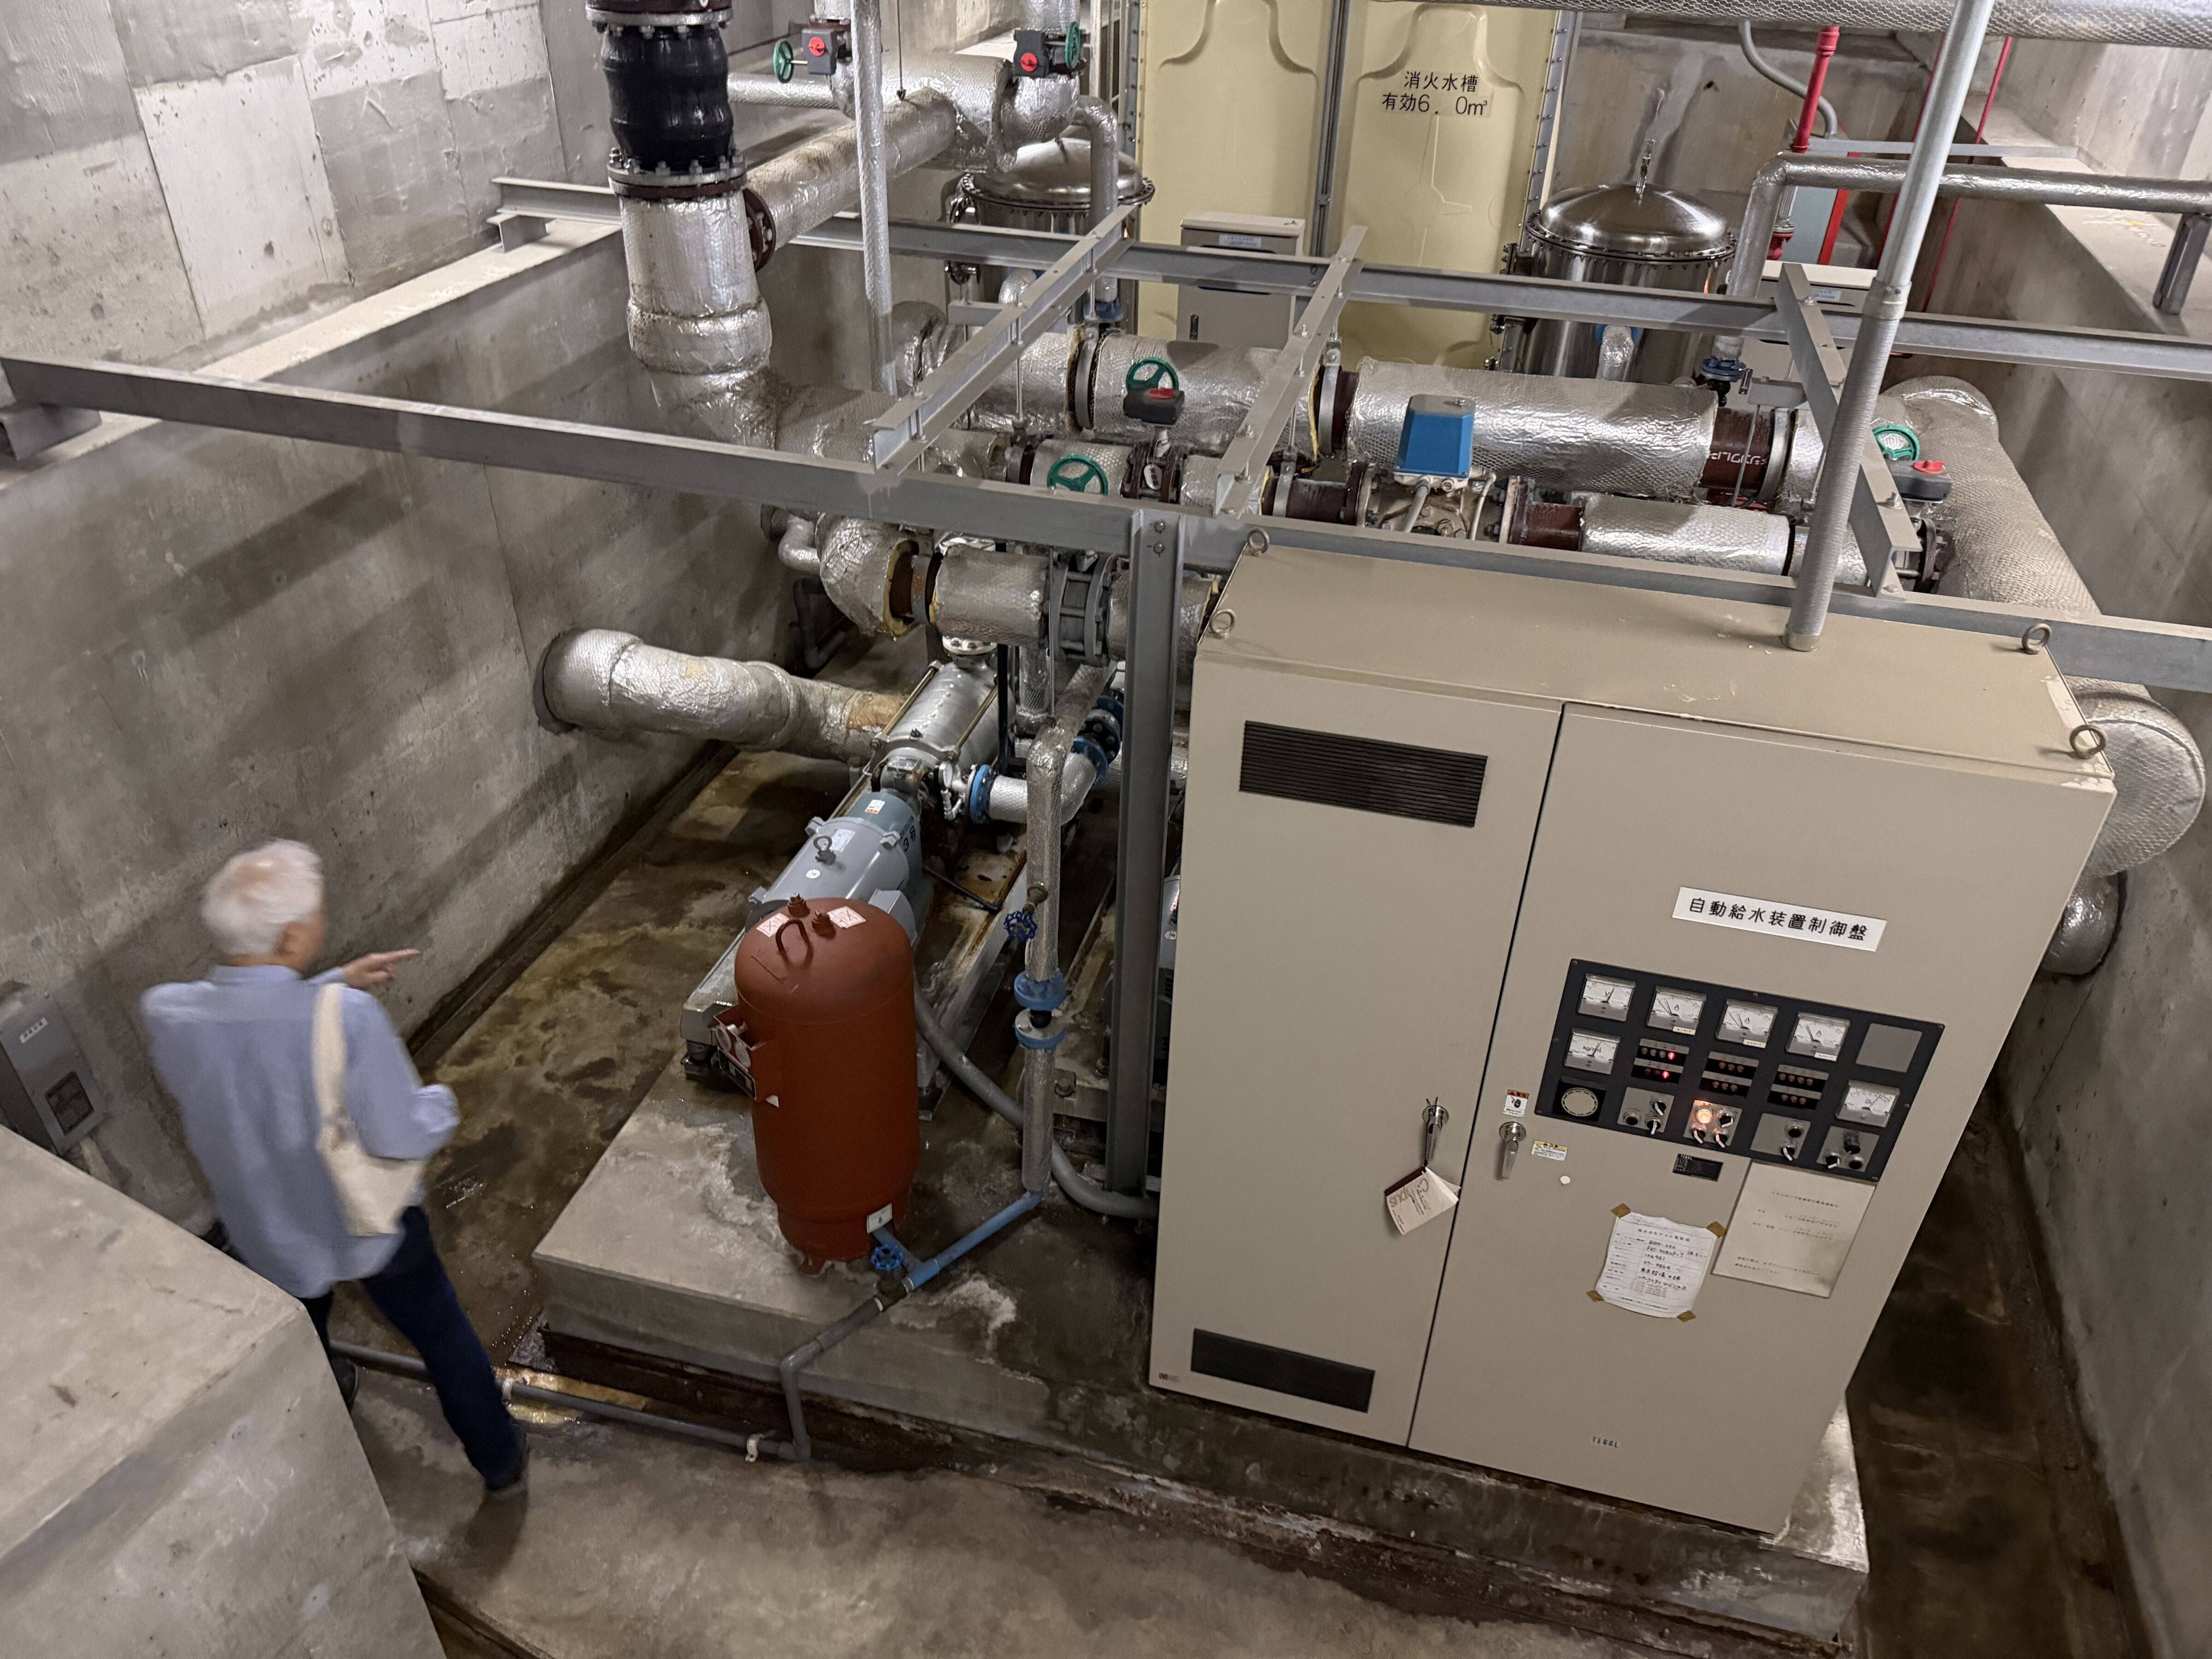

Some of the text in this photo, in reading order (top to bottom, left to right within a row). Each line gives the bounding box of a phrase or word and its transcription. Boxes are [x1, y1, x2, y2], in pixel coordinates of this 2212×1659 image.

[1404, 71, 1478, 92] 消火水槽
[1689, 898, 1867, 941] 自動給水装置制御盤
